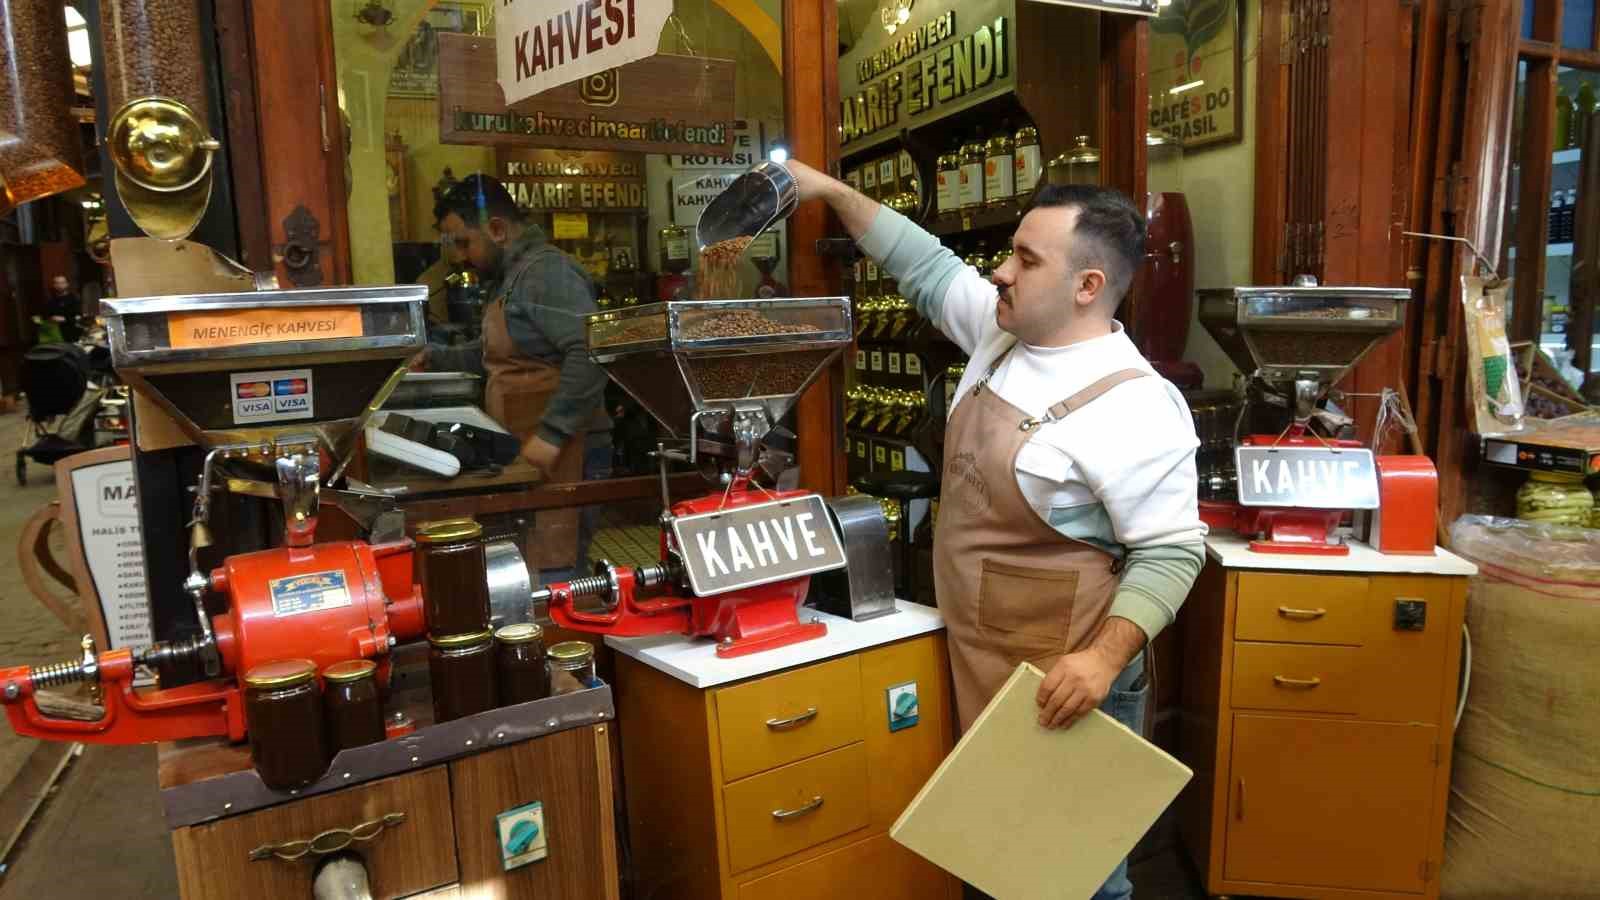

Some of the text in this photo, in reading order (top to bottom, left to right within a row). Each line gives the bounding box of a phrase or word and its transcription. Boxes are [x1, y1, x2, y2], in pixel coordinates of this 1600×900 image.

[1206, 88, 1229, 111] DO
[193, 321, 273, 339] MENENGİÇ
[242, 402, 270, 412] VISA
[280, 398, 306, 408] VISA
[696, 512, 825, 577] KAHVE
